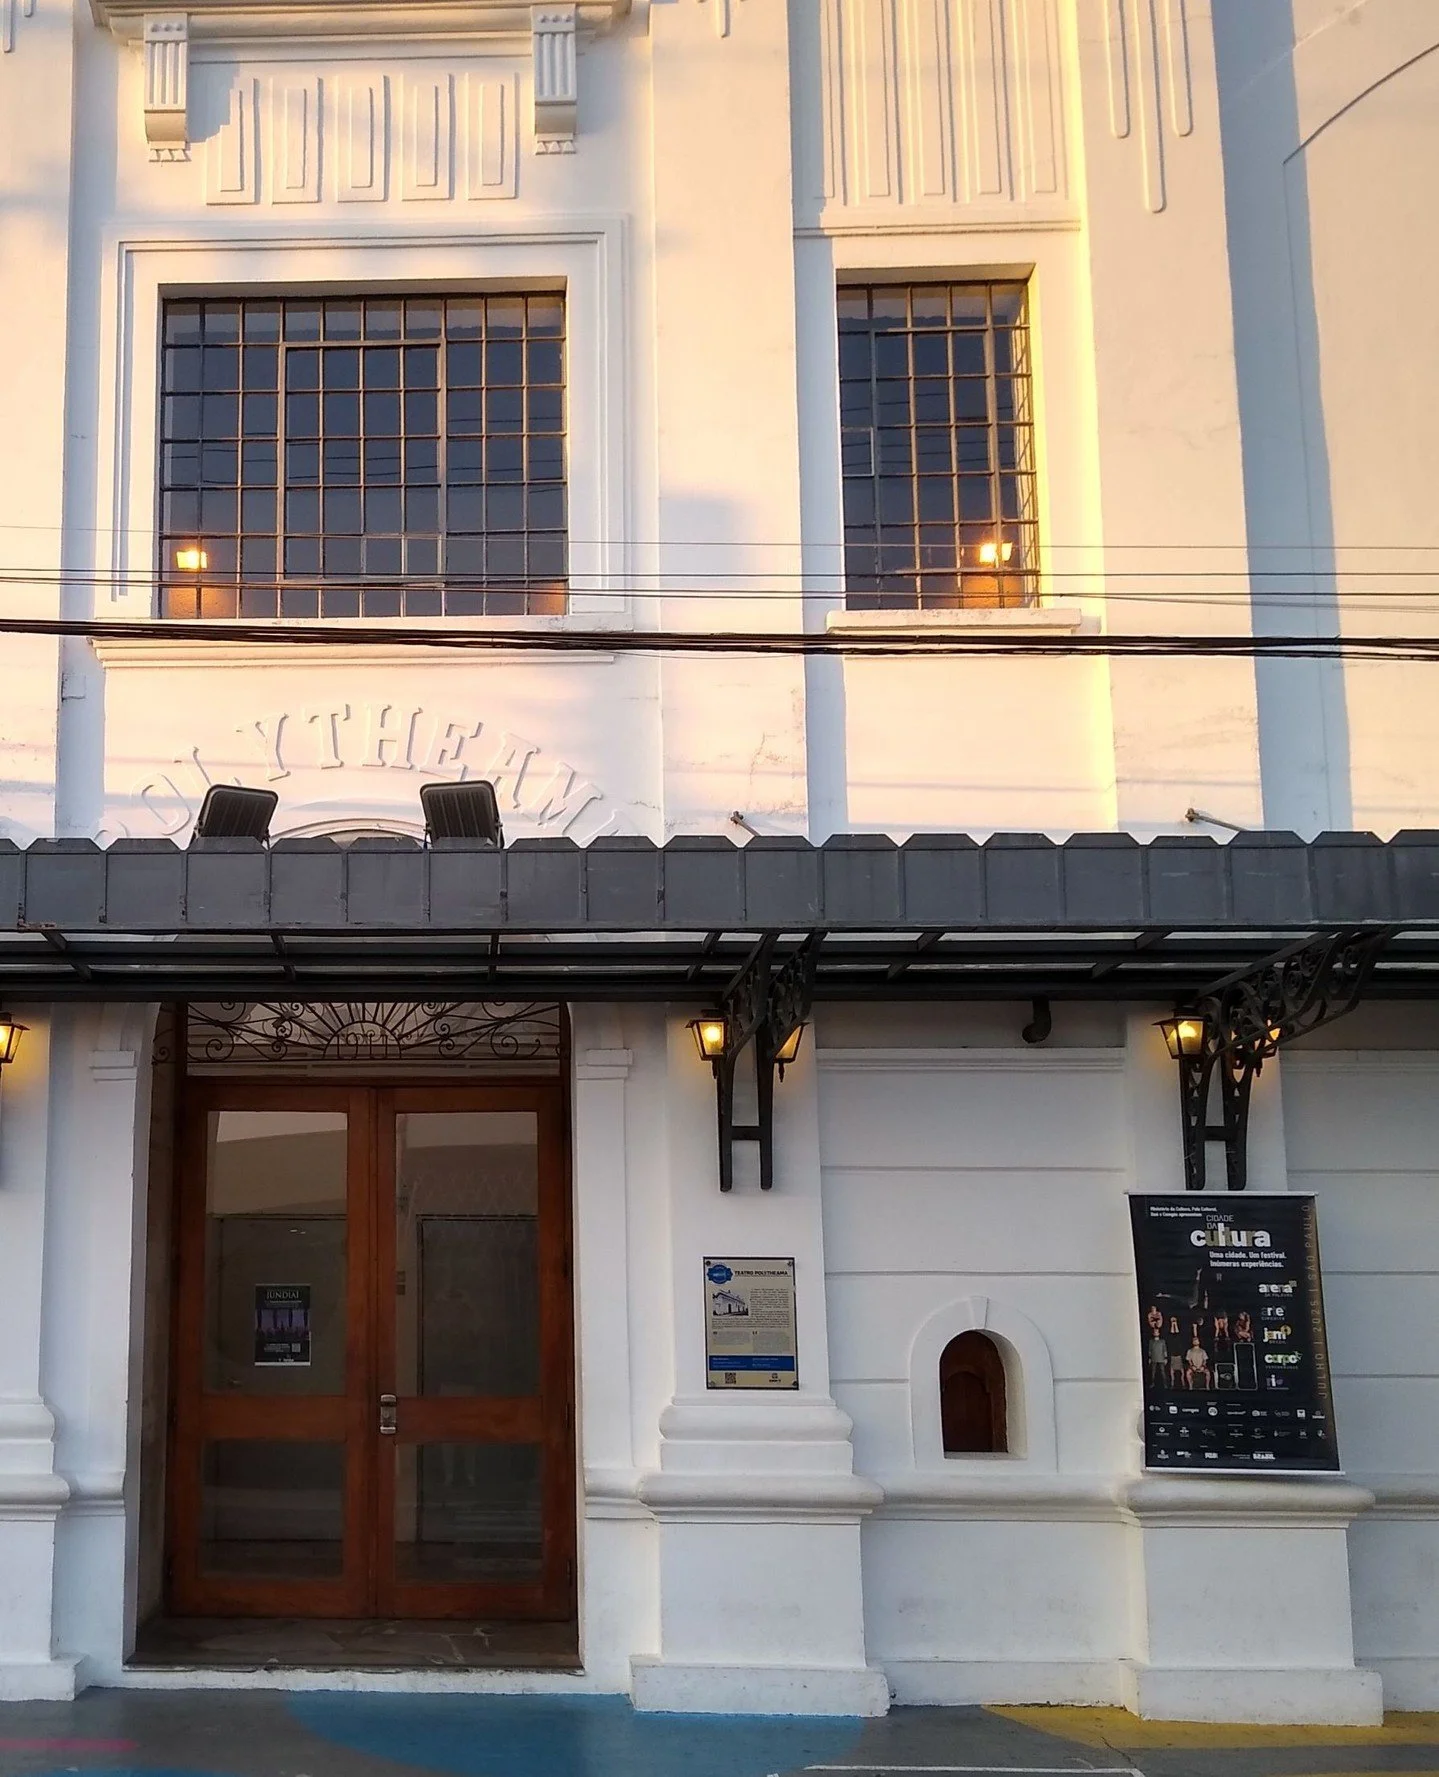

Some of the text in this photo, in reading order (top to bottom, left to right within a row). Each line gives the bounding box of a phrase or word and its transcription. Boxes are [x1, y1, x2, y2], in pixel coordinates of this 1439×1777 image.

[1190, 1222, 1271, 1247] cultura
[1209, 1251, 1287, 1259] Uma cidade. Um festival.
[1259, 1283, 1293, 1293] arena
[1315, 1353, 1327, 1398] JULHO
